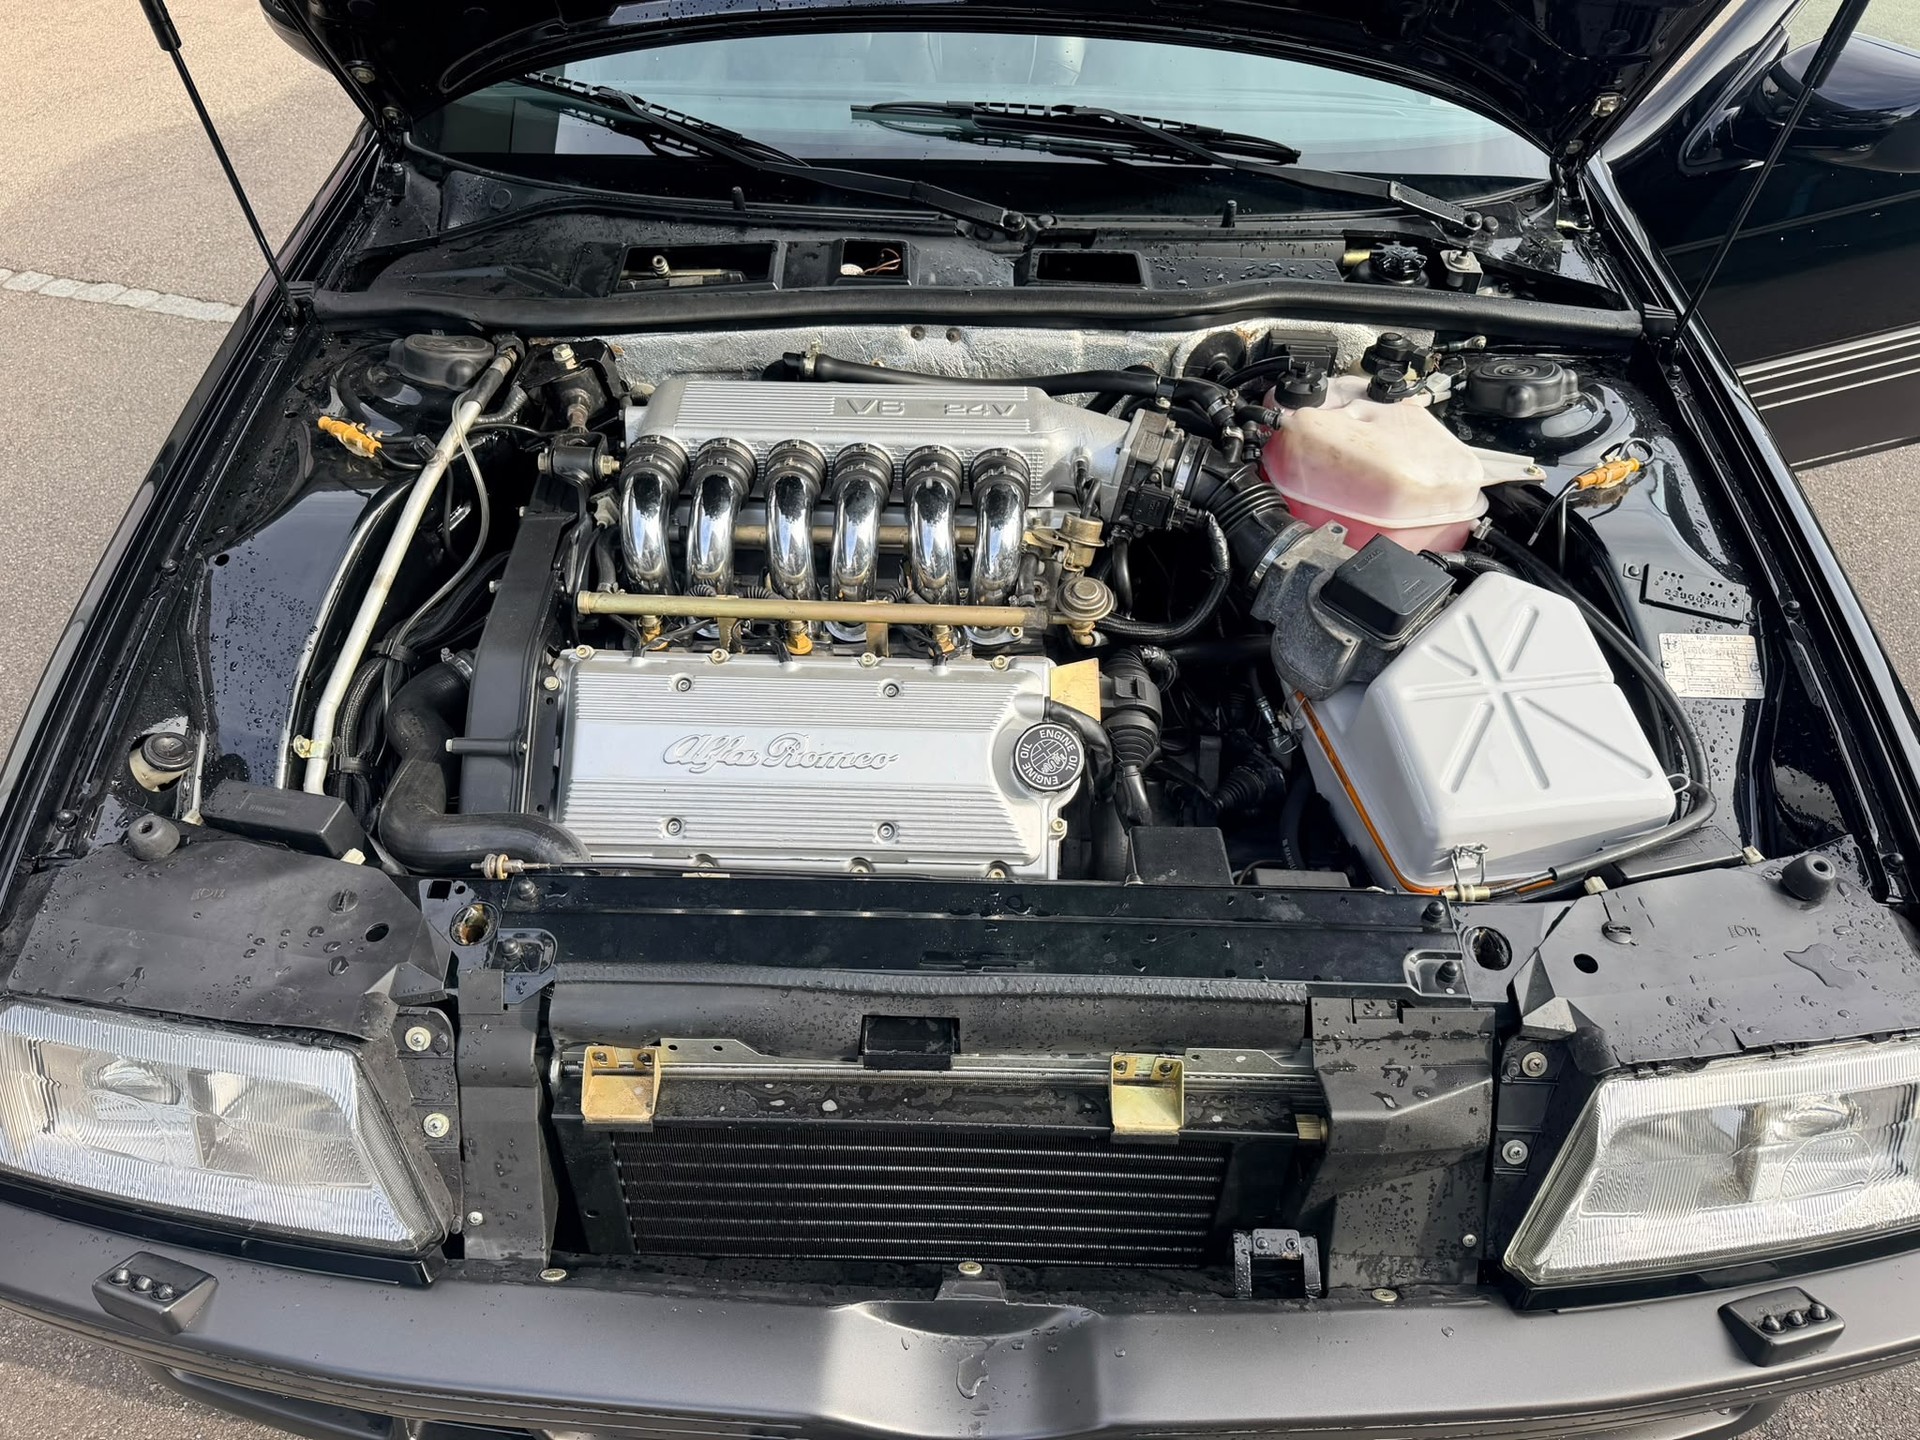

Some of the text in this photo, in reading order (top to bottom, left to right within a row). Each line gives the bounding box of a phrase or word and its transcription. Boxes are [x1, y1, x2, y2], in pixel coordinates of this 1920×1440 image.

[846, 399, 1017, 417] V6 24V
[662, 732, 900, 774] Alfa Romeo
[1020, 743, 1059, 786] ENGINE OIL
[1039, 729, 1078, 771] ENGINE OIL
